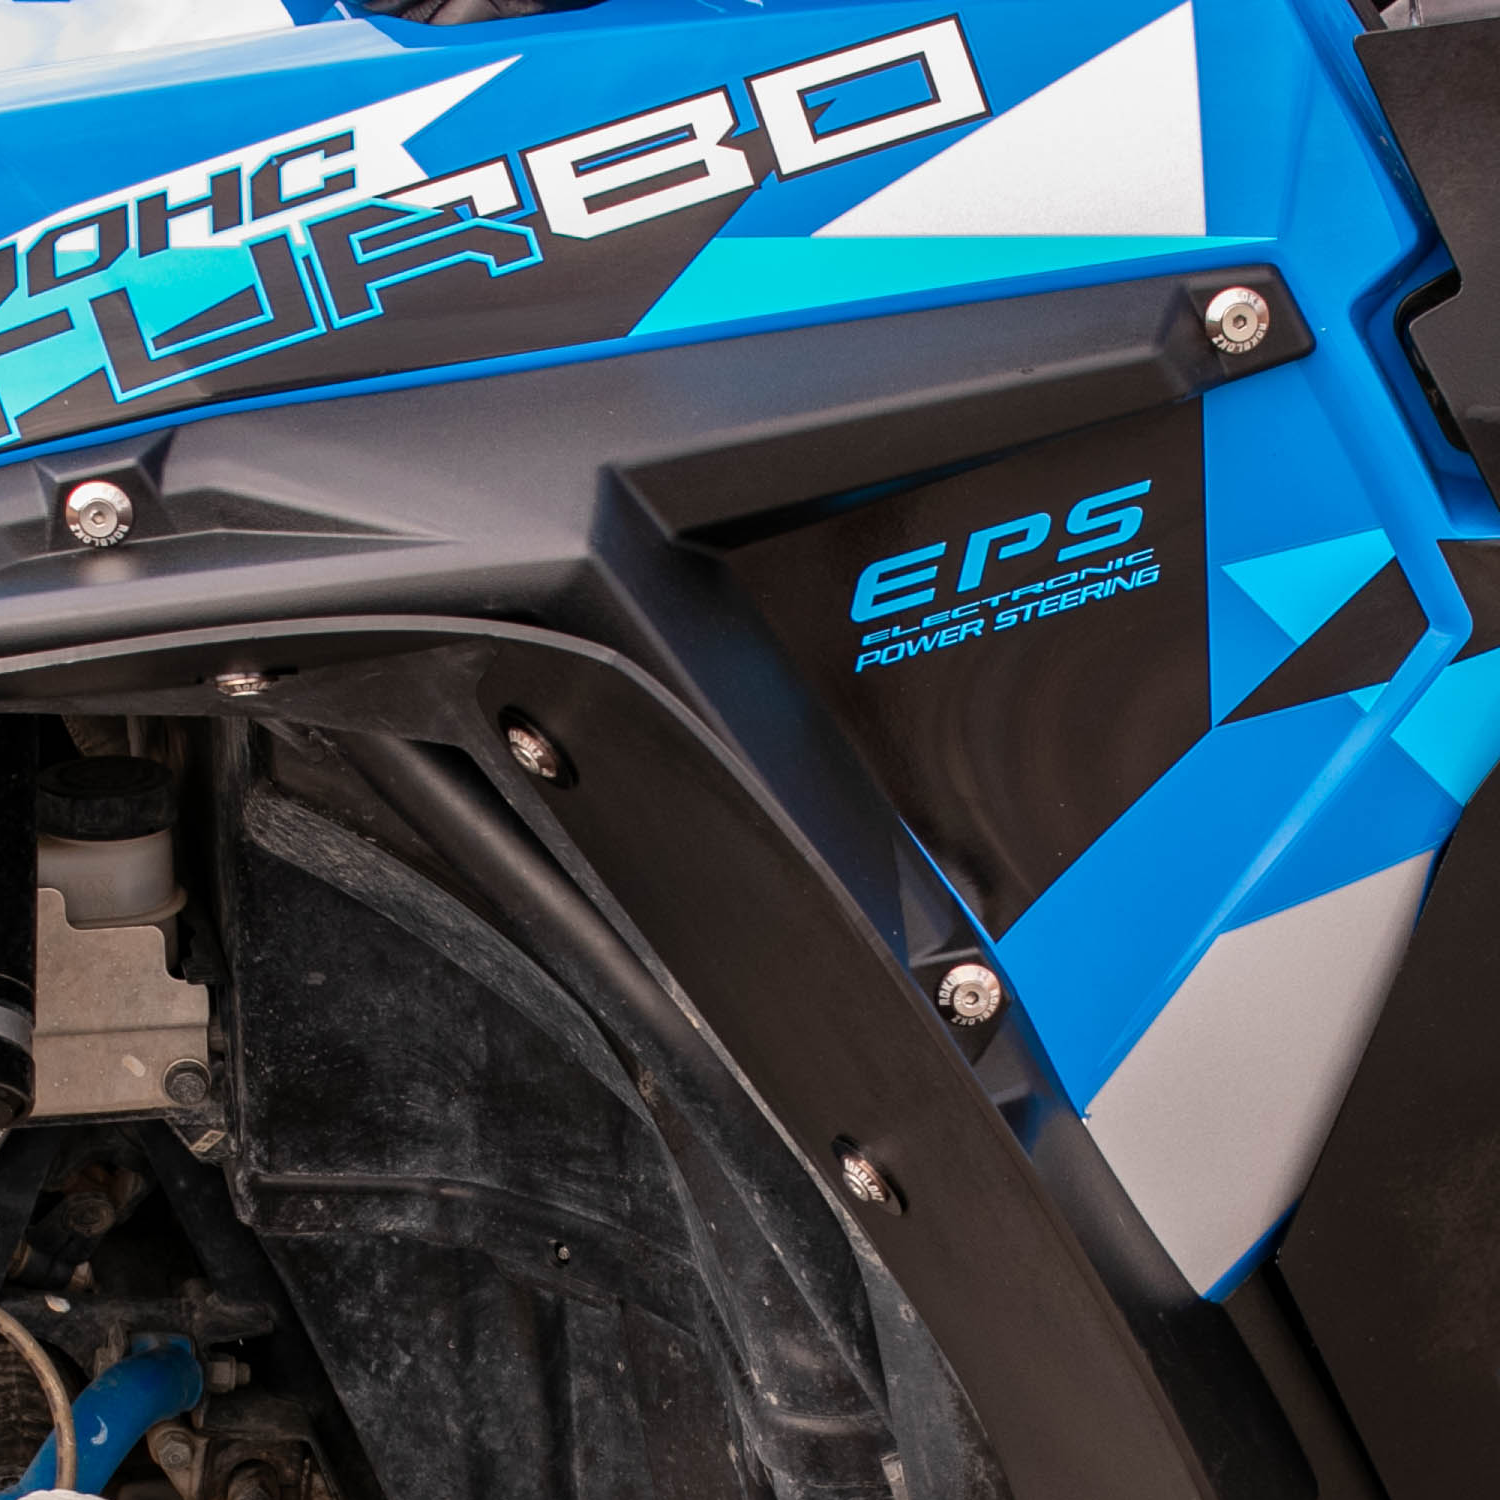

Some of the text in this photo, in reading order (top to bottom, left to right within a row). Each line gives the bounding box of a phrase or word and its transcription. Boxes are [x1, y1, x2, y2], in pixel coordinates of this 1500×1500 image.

[850, 479, 1152, 624] EPS
[860, 547, 1156, 648] ELECTRONIC
[854, 564, 1161, 674] POWER STEERING
